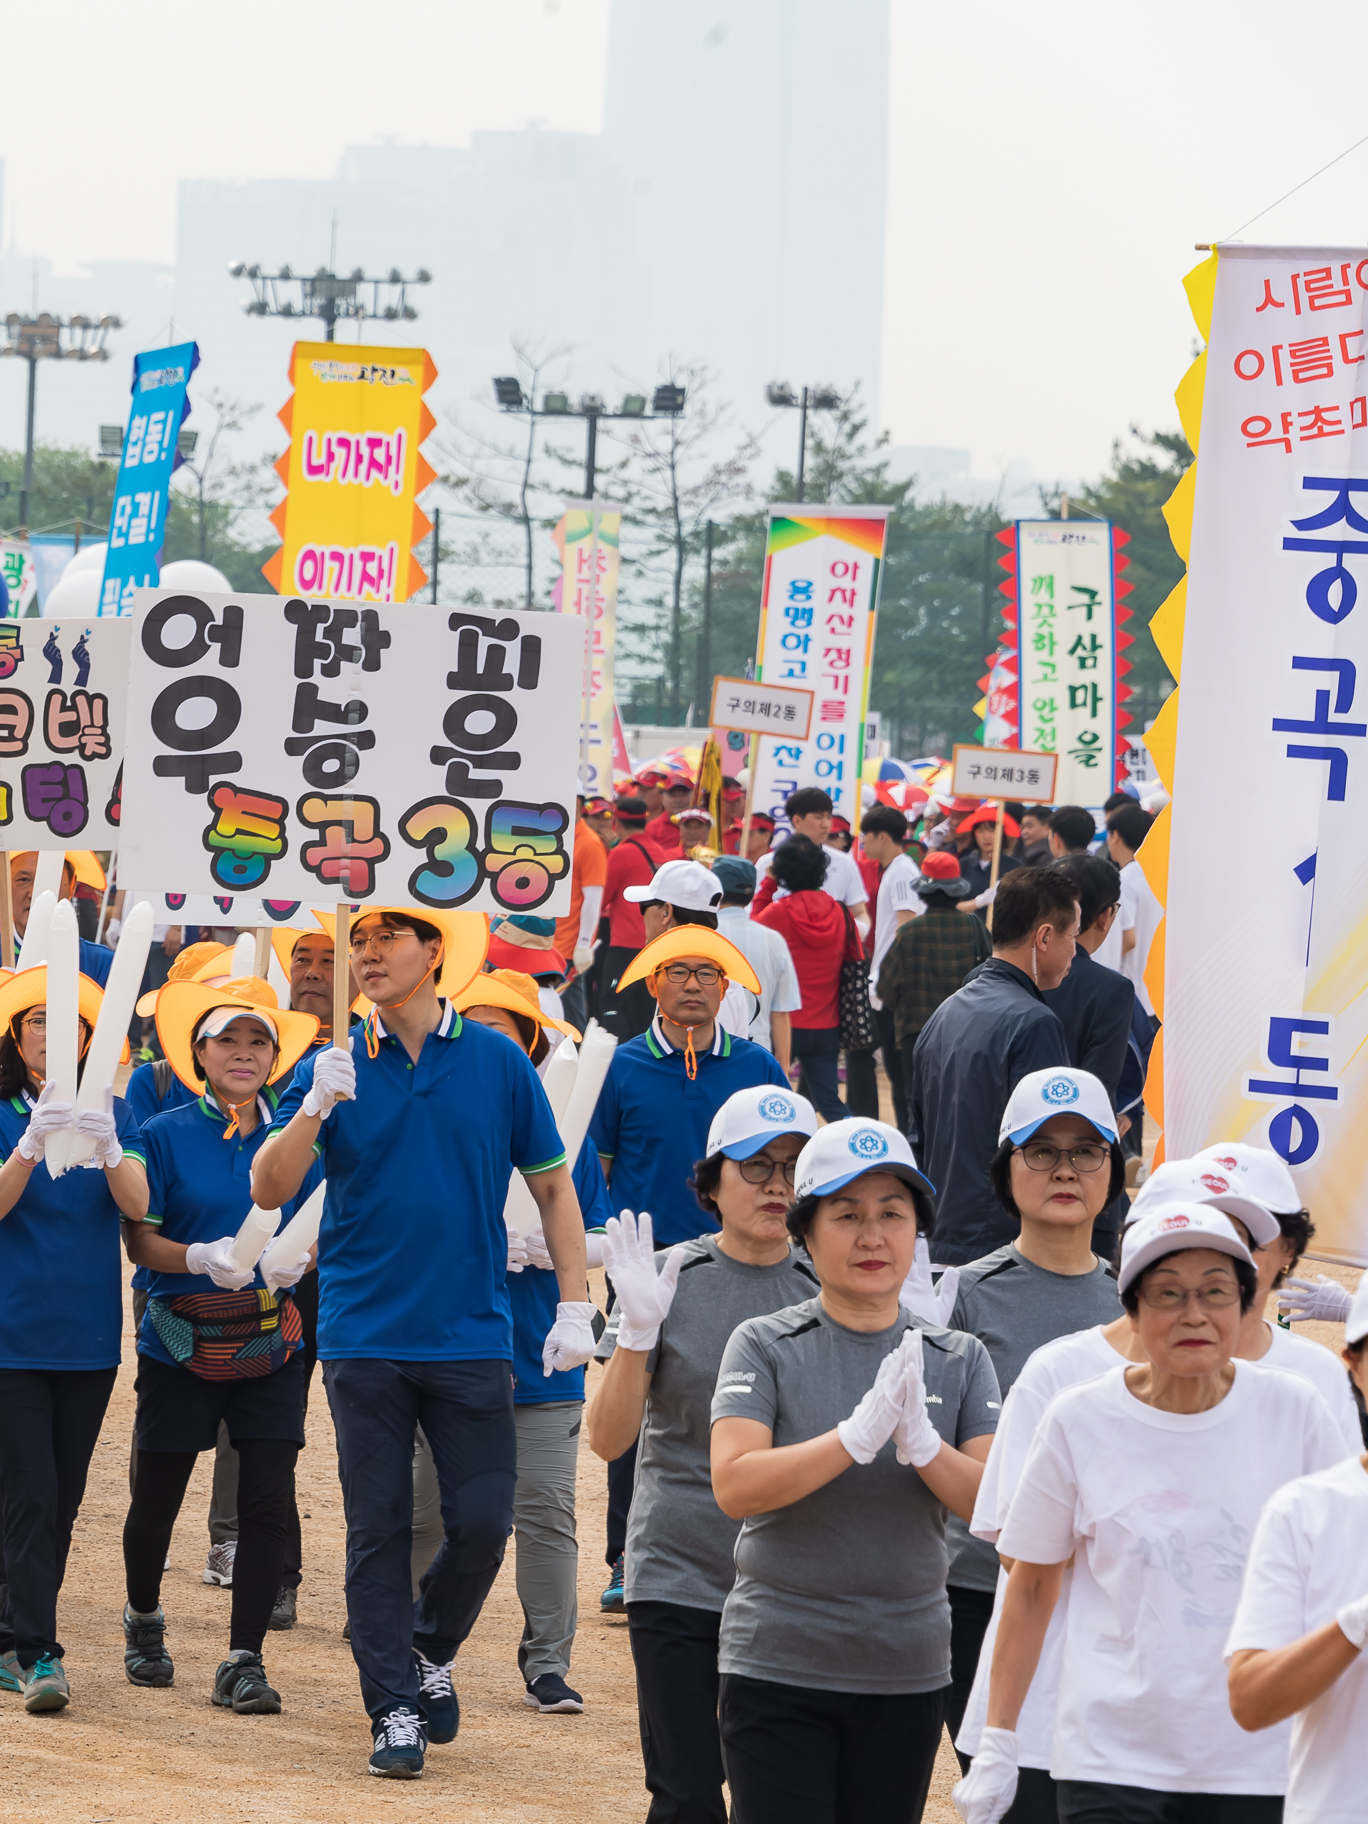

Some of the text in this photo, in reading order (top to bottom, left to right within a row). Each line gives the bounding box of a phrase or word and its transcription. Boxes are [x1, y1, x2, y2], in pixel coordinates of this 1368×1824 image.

[124, 409, 174, 469] 협동!
[305, 432, 403, 492] 나가자!
[110, 490, 160, 549] 단결!
[297, 545, 394, 602] 이기자!
[1030, 573, 1060, 685] 깨끗하고
[1066, 584, 1104, 769] 구삼마을
[149, 674, 523, 799] 우승은
[726, 696, 797, 722] 구의제2동
[966, 764, 1041, 786] 구의제3동
[202, 780, 571, 912] 중곡3동
[1248, 475, 1368, 1166] 중곡동
